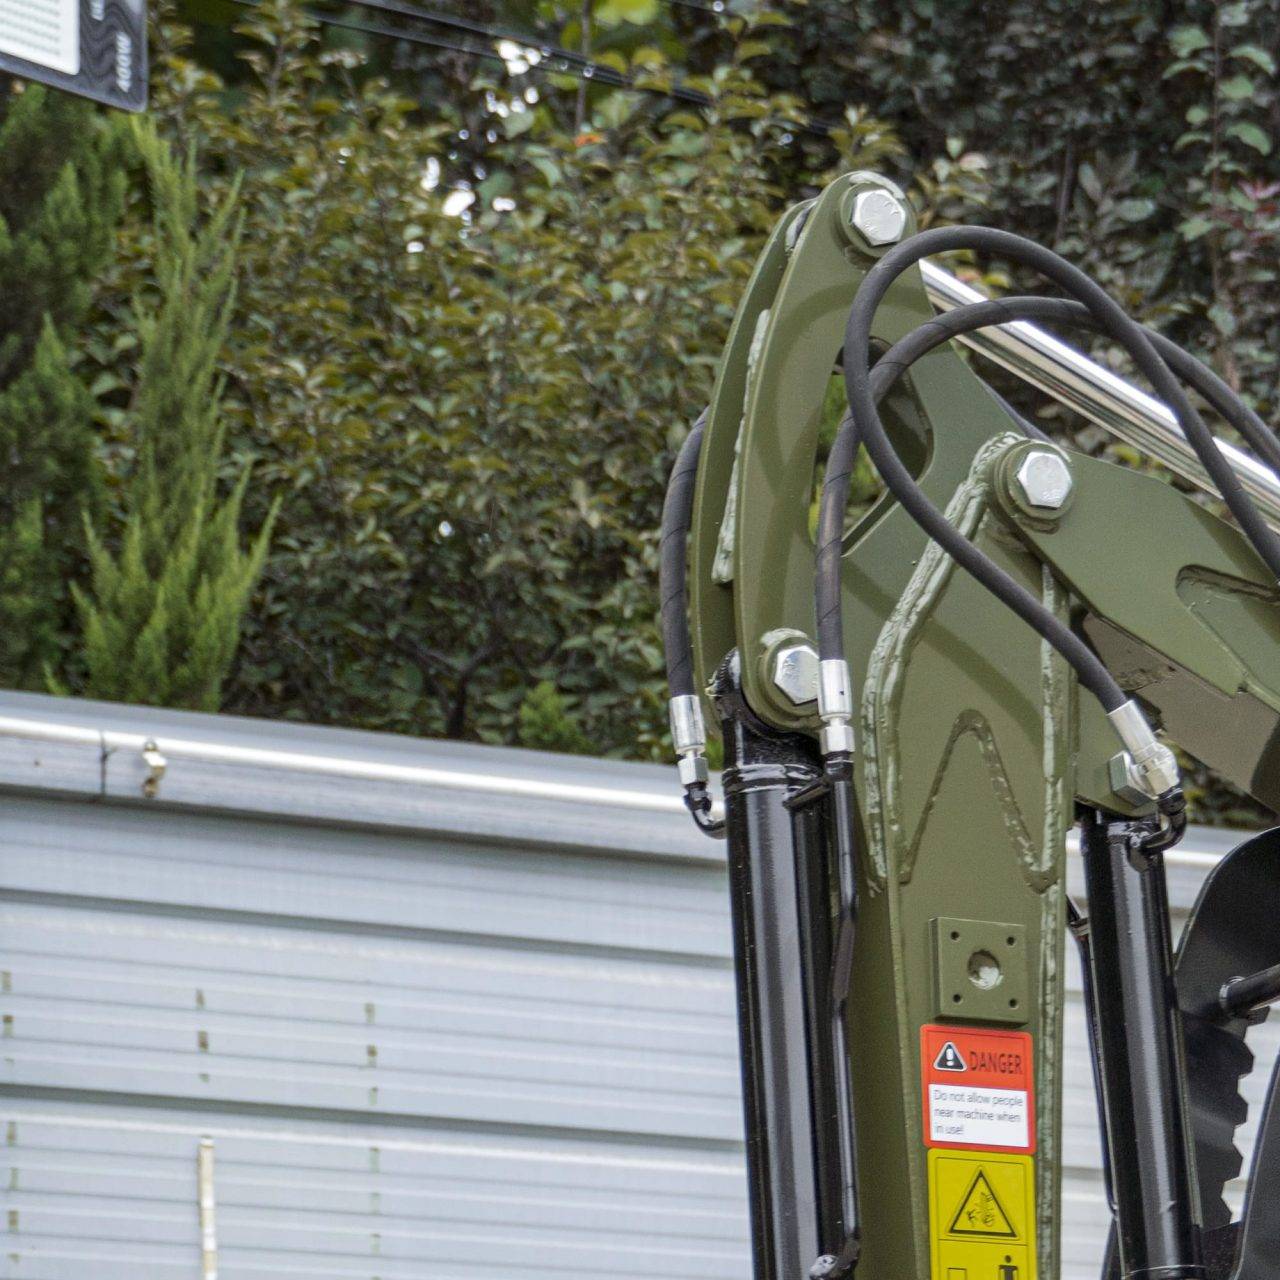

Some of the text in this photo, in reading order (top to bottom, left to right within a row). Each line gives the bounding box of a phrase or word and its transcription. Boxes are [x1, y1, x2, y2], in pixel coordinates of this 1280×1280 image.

[969, 1051, 1022, 1074] DANGER
[933, 1089, 1023, 1107] Do not allow people
[934, 1108, 1021, 1122] near machine when
